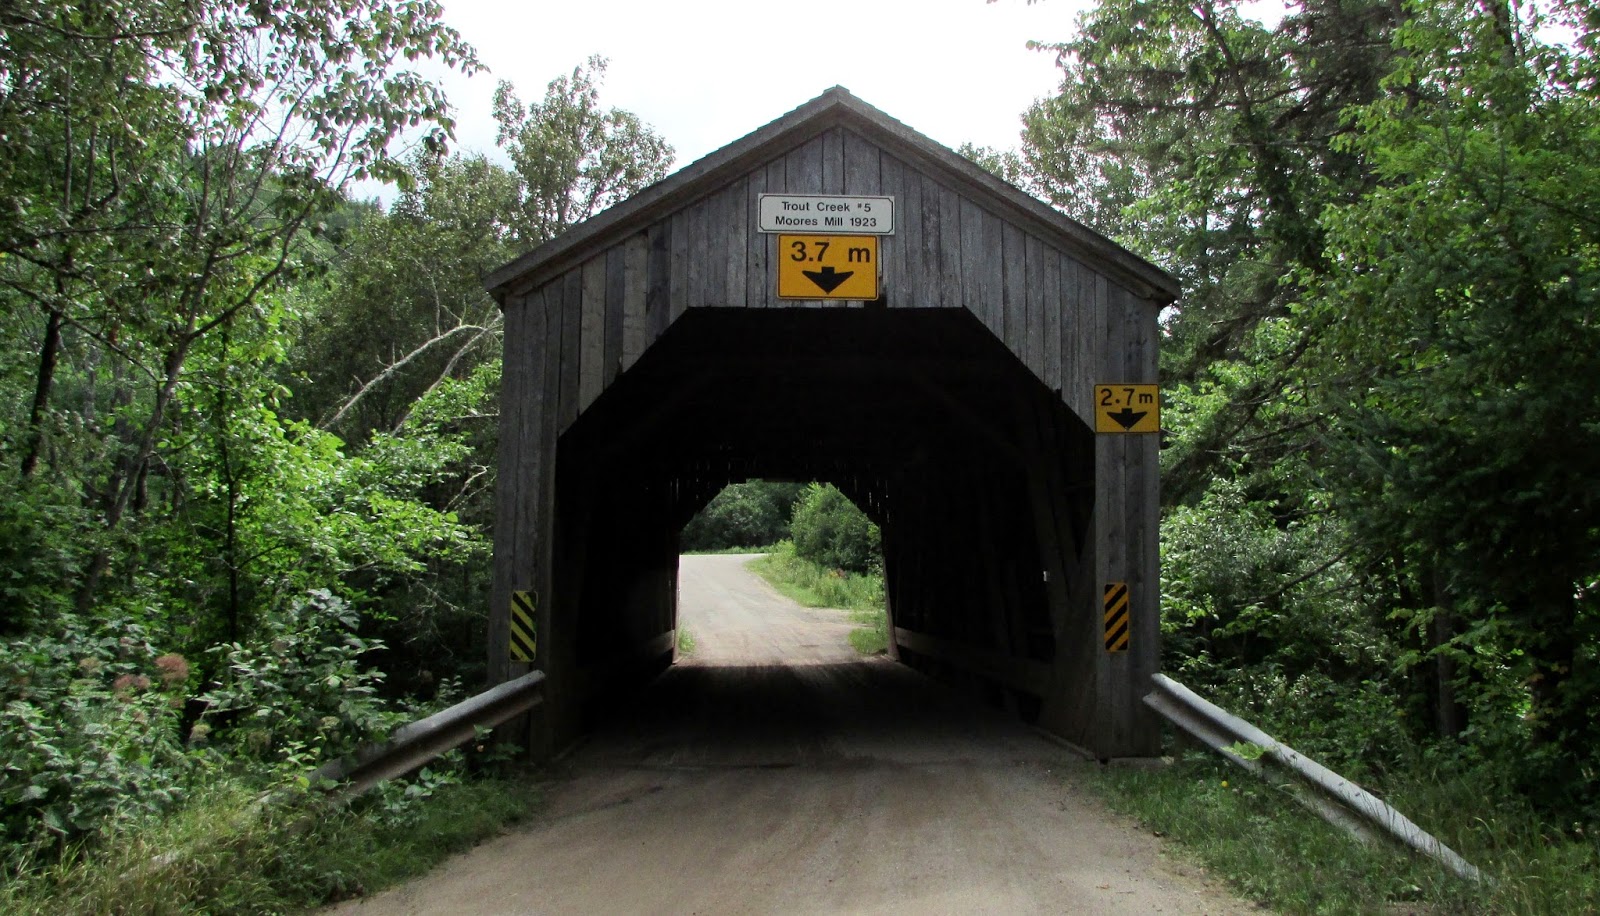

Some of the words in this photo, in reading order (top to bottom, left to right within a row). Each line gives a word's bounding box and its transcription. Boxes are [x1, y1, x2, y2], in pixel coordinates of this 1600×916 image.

[781, 201, 810, 212] Trout
[817, 202, 850, 212] Creek
[857, 203, 872, 212] #5
[775, 216, 818, 226] Moores
[824, 217, 843, 227] Mill
[850, 218, 877, 227] 1923
[791, 241, 830, 262] 3.7
[848, 247, 870, 263] m
